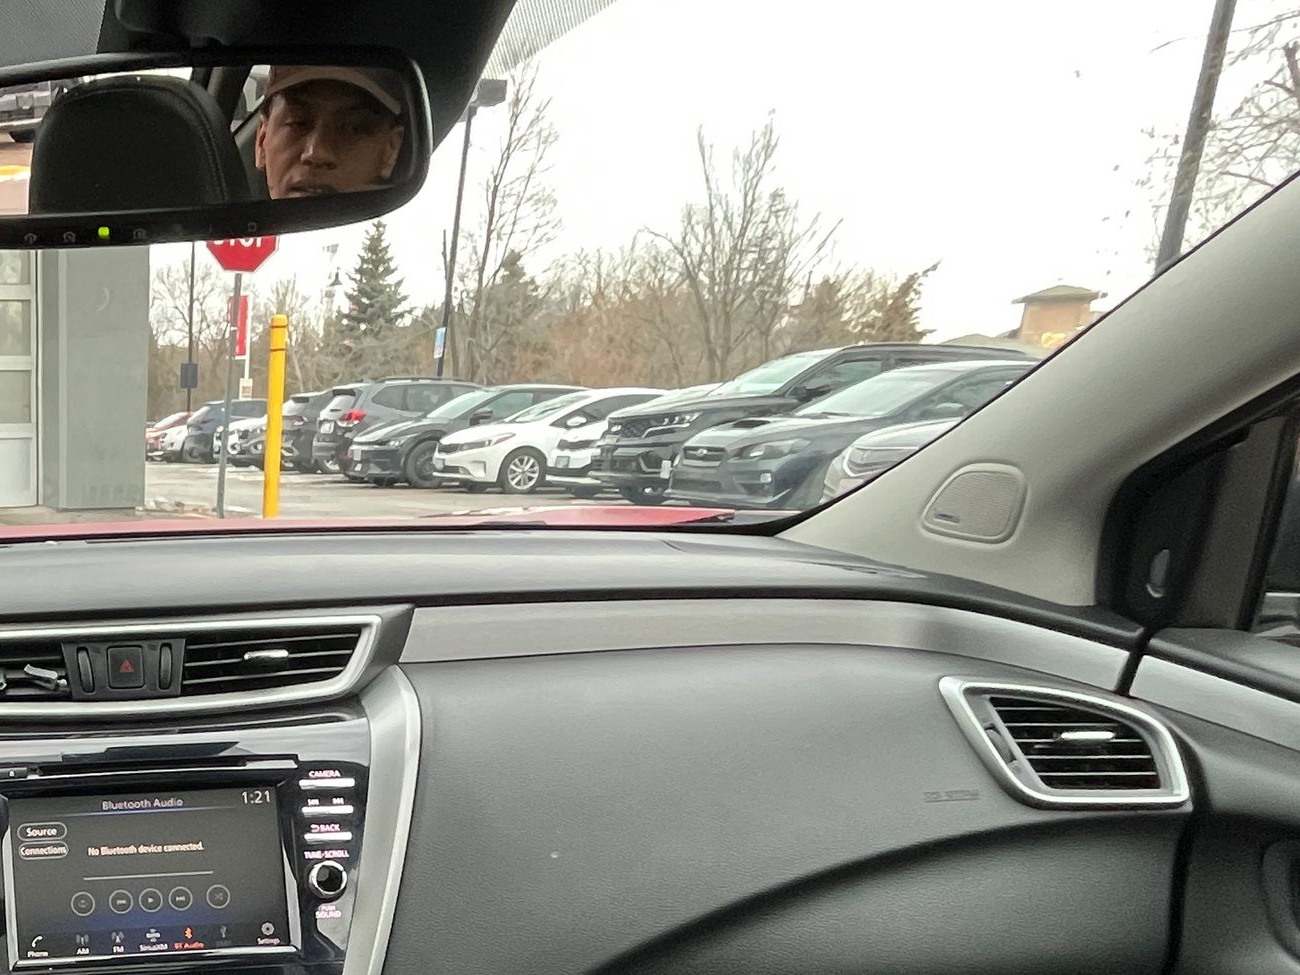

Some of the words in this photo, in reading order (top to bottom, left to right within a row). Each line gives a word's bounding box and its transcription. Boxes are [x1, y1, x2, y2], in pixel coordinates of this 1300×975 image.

[308, 770, 341, 778] CAMERA
[241, 790, 271, 804] 1:21
[102, 799, 151, 810] Bluetooth
[153, 797, 184, 808] Audio
[26, 827, 58, 837] Source
[319, 824, 340, 832] BACK
[20, 845, 67, 856] Connections
[87, 846, 100, 856] No
[100, 844, 137, 855] Bluetooth
[138, 842, 162, 853] device
